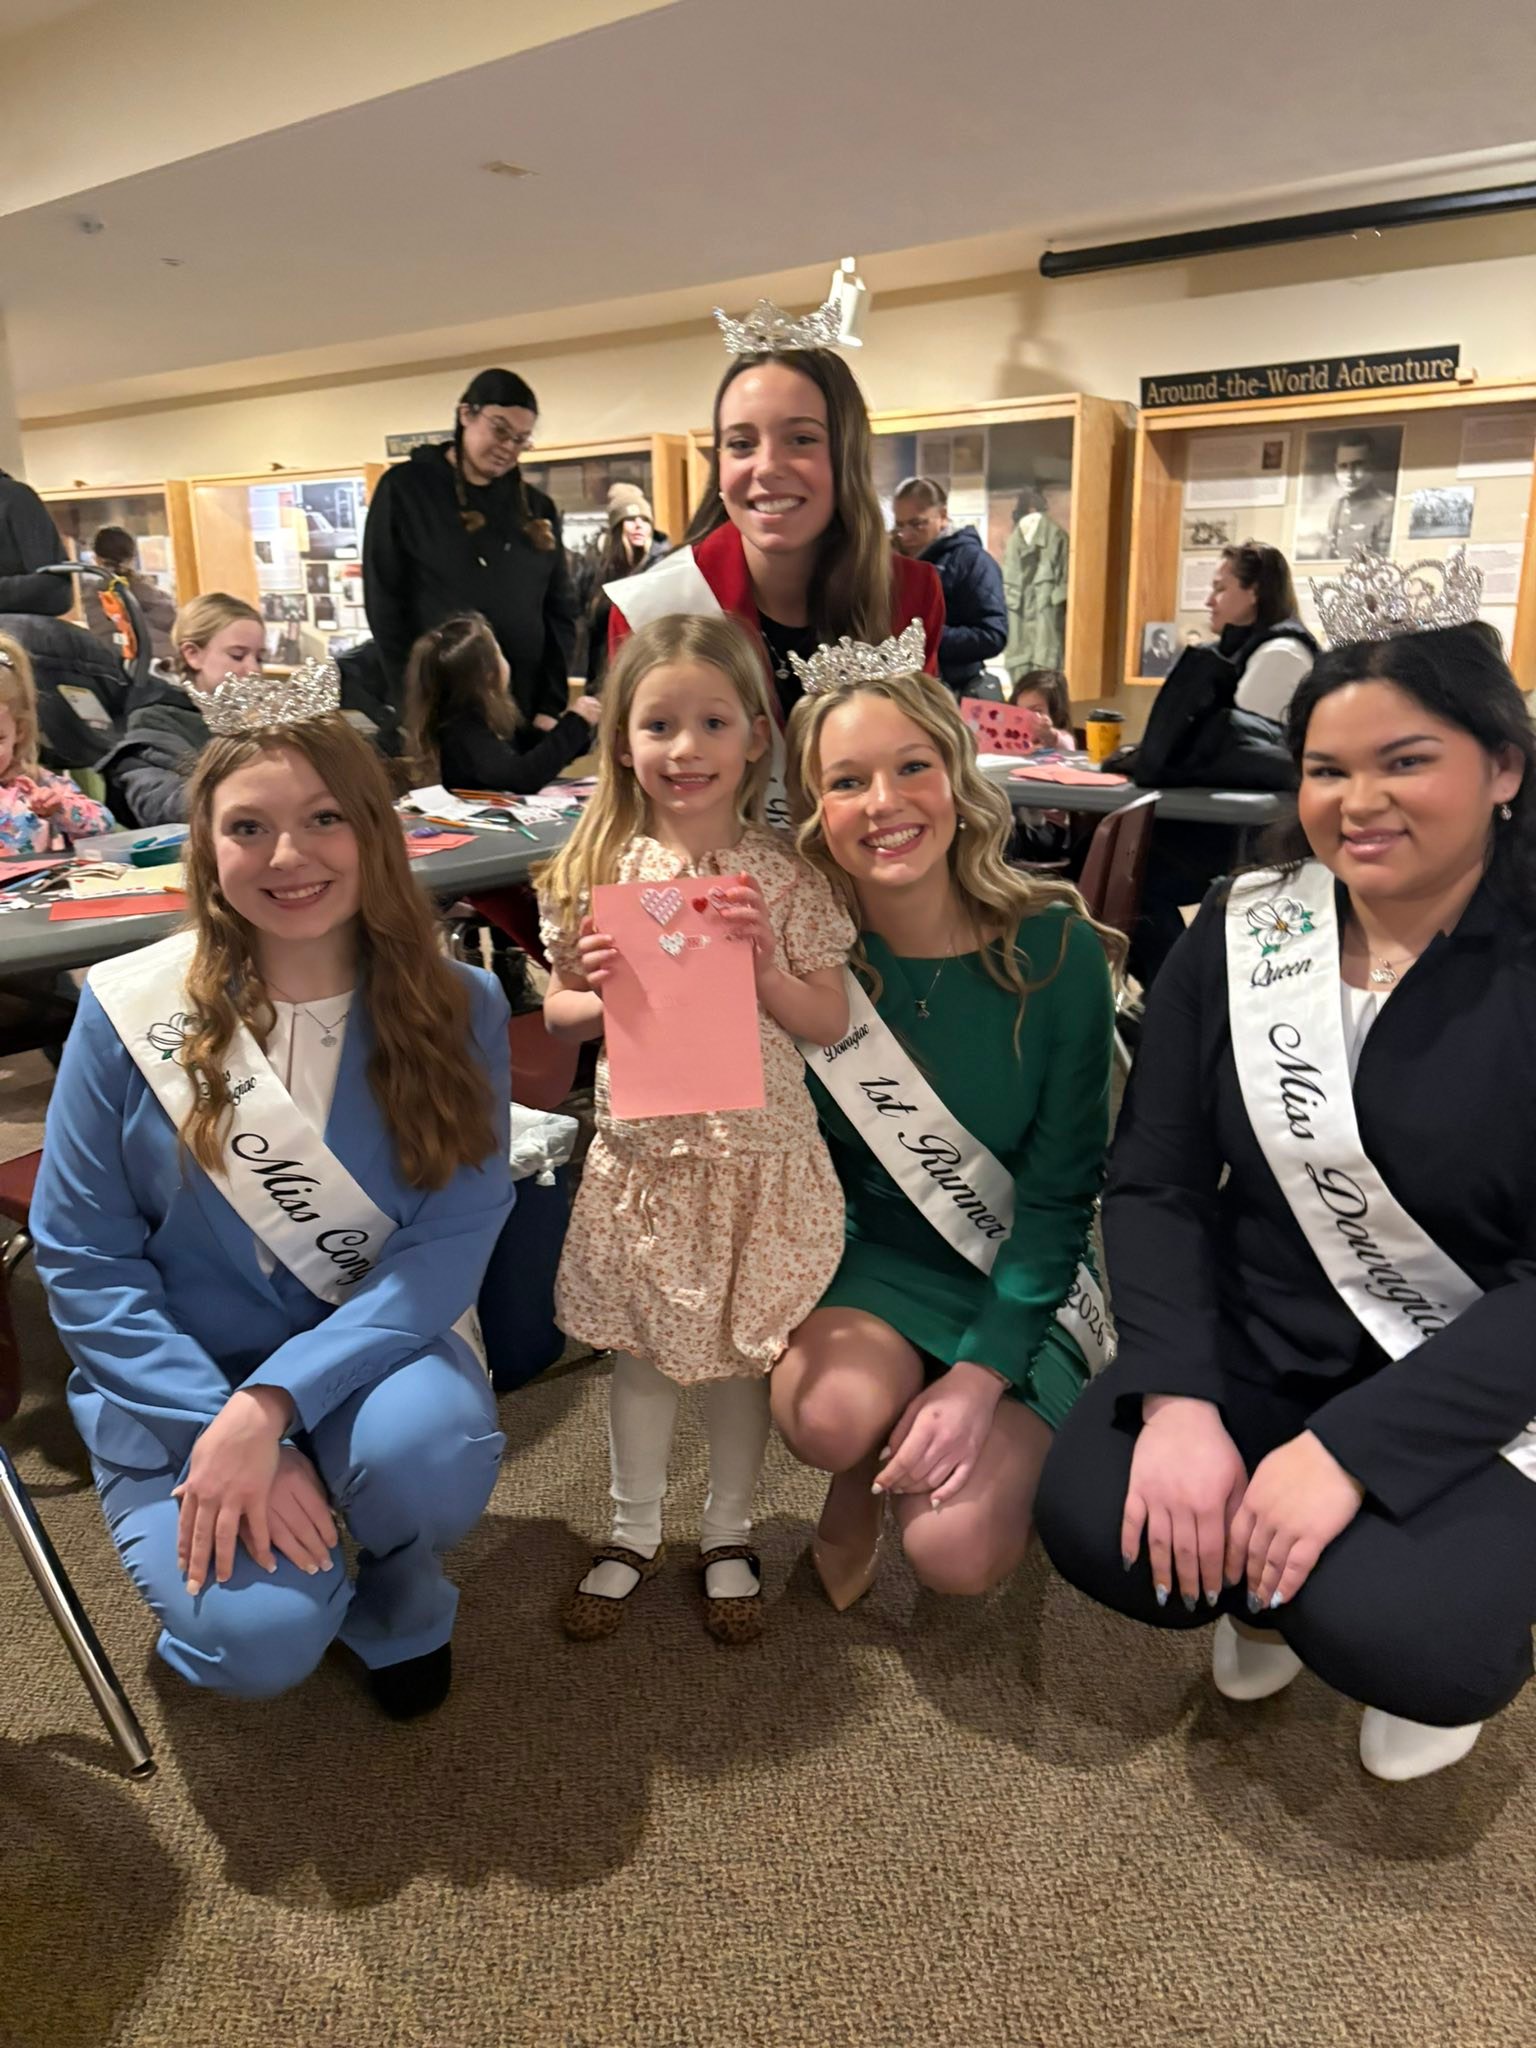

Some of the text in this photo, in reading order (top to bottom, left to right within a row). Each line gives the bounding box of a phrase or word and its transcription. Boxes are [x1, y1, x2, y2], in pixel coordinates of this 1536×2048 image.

[1146, 355, 1453, 404] Around-the-World Adventure
[1250, 957, 1313, 989] Queen
[1269, 1023, 1326, 1141] Miss
[231, 1133, 321, 1223] Miss
[858, 1076, 1007, 1239] 1st Runner
